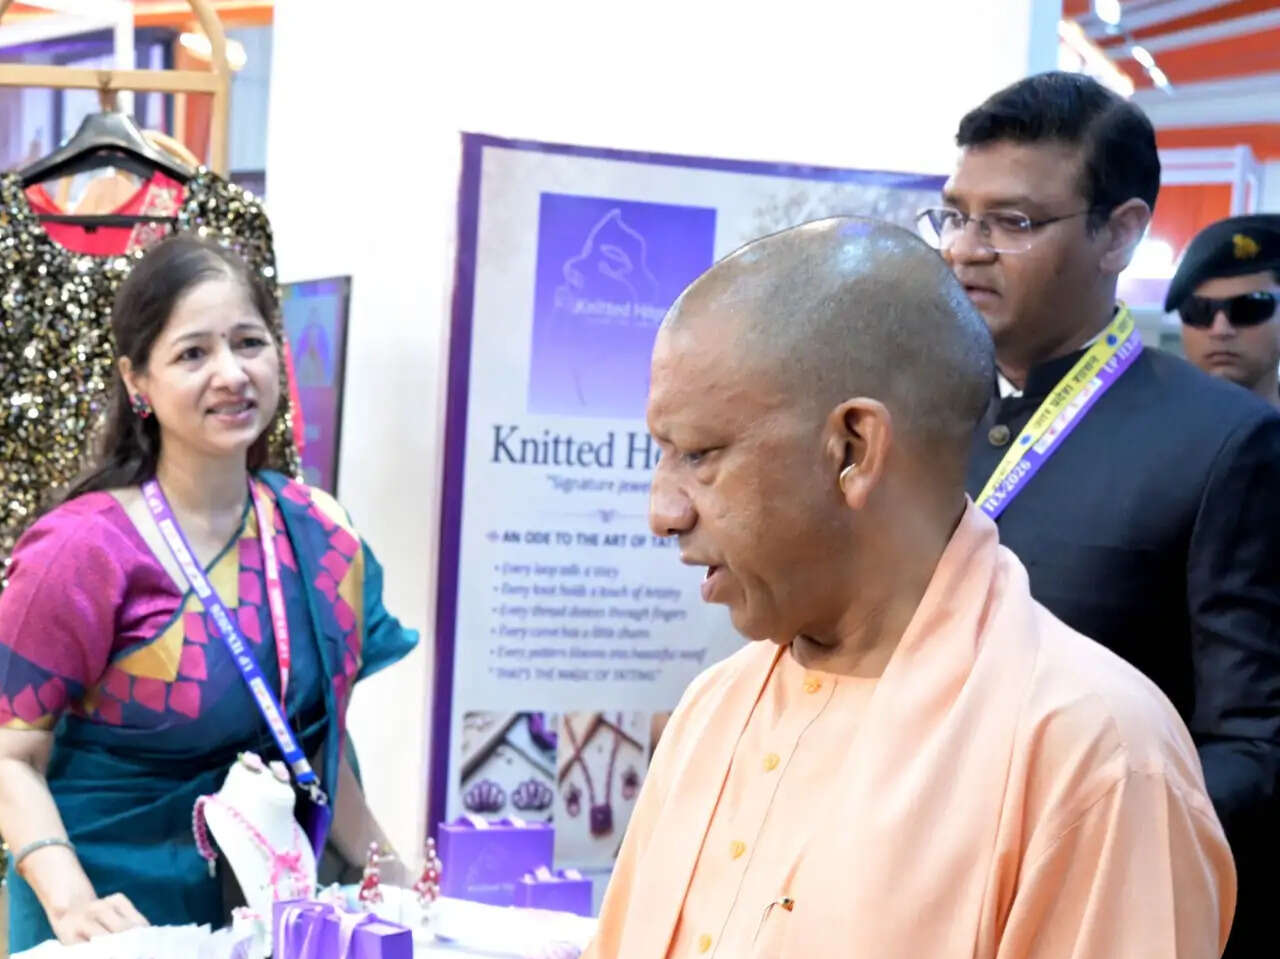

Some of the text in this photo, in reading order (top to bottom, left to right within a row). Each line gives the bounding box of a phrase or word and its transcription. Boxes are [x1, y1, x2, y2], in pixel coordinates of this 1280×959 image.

[490, 425, 615, 468] Knitted
[503, 531, 520, 544] AN
[556, 532, 573, 546] TO
[576, 533, 599, 547] THE
[603, 534, 627, 548] ART
[631, 535, 647, 548] OF
[235, 654, 253, 673] UP
